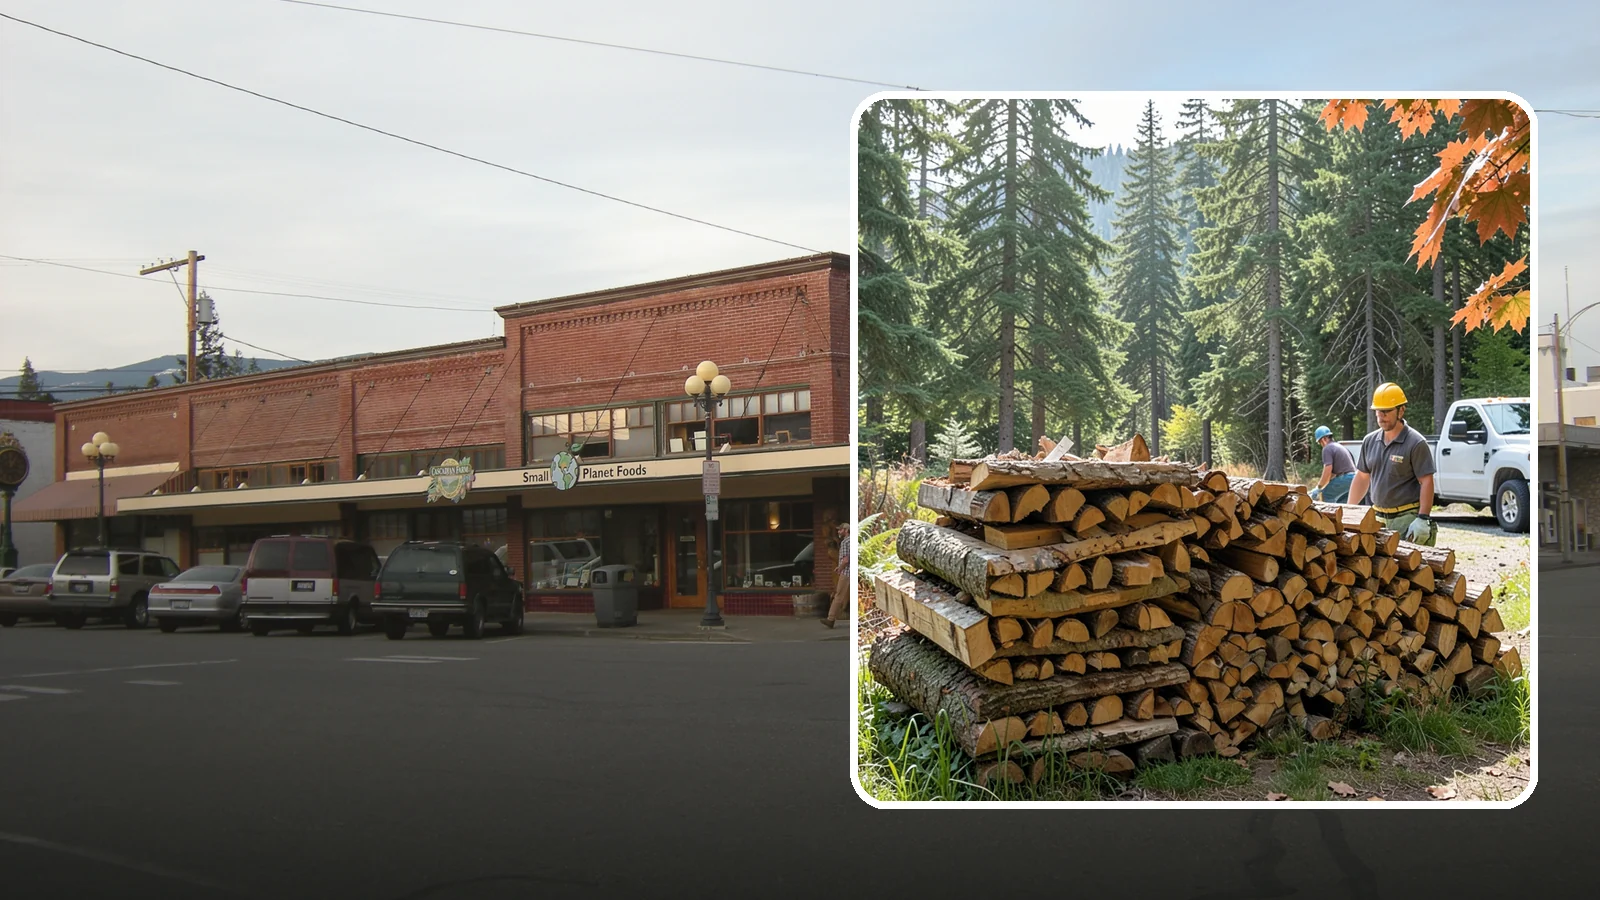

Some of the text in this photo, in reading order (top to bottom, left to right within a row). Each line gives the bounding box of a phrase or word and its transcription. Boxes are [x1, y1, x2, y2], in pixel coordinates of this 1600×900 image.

[523, 464, 647, 483] Small Planet Foods
